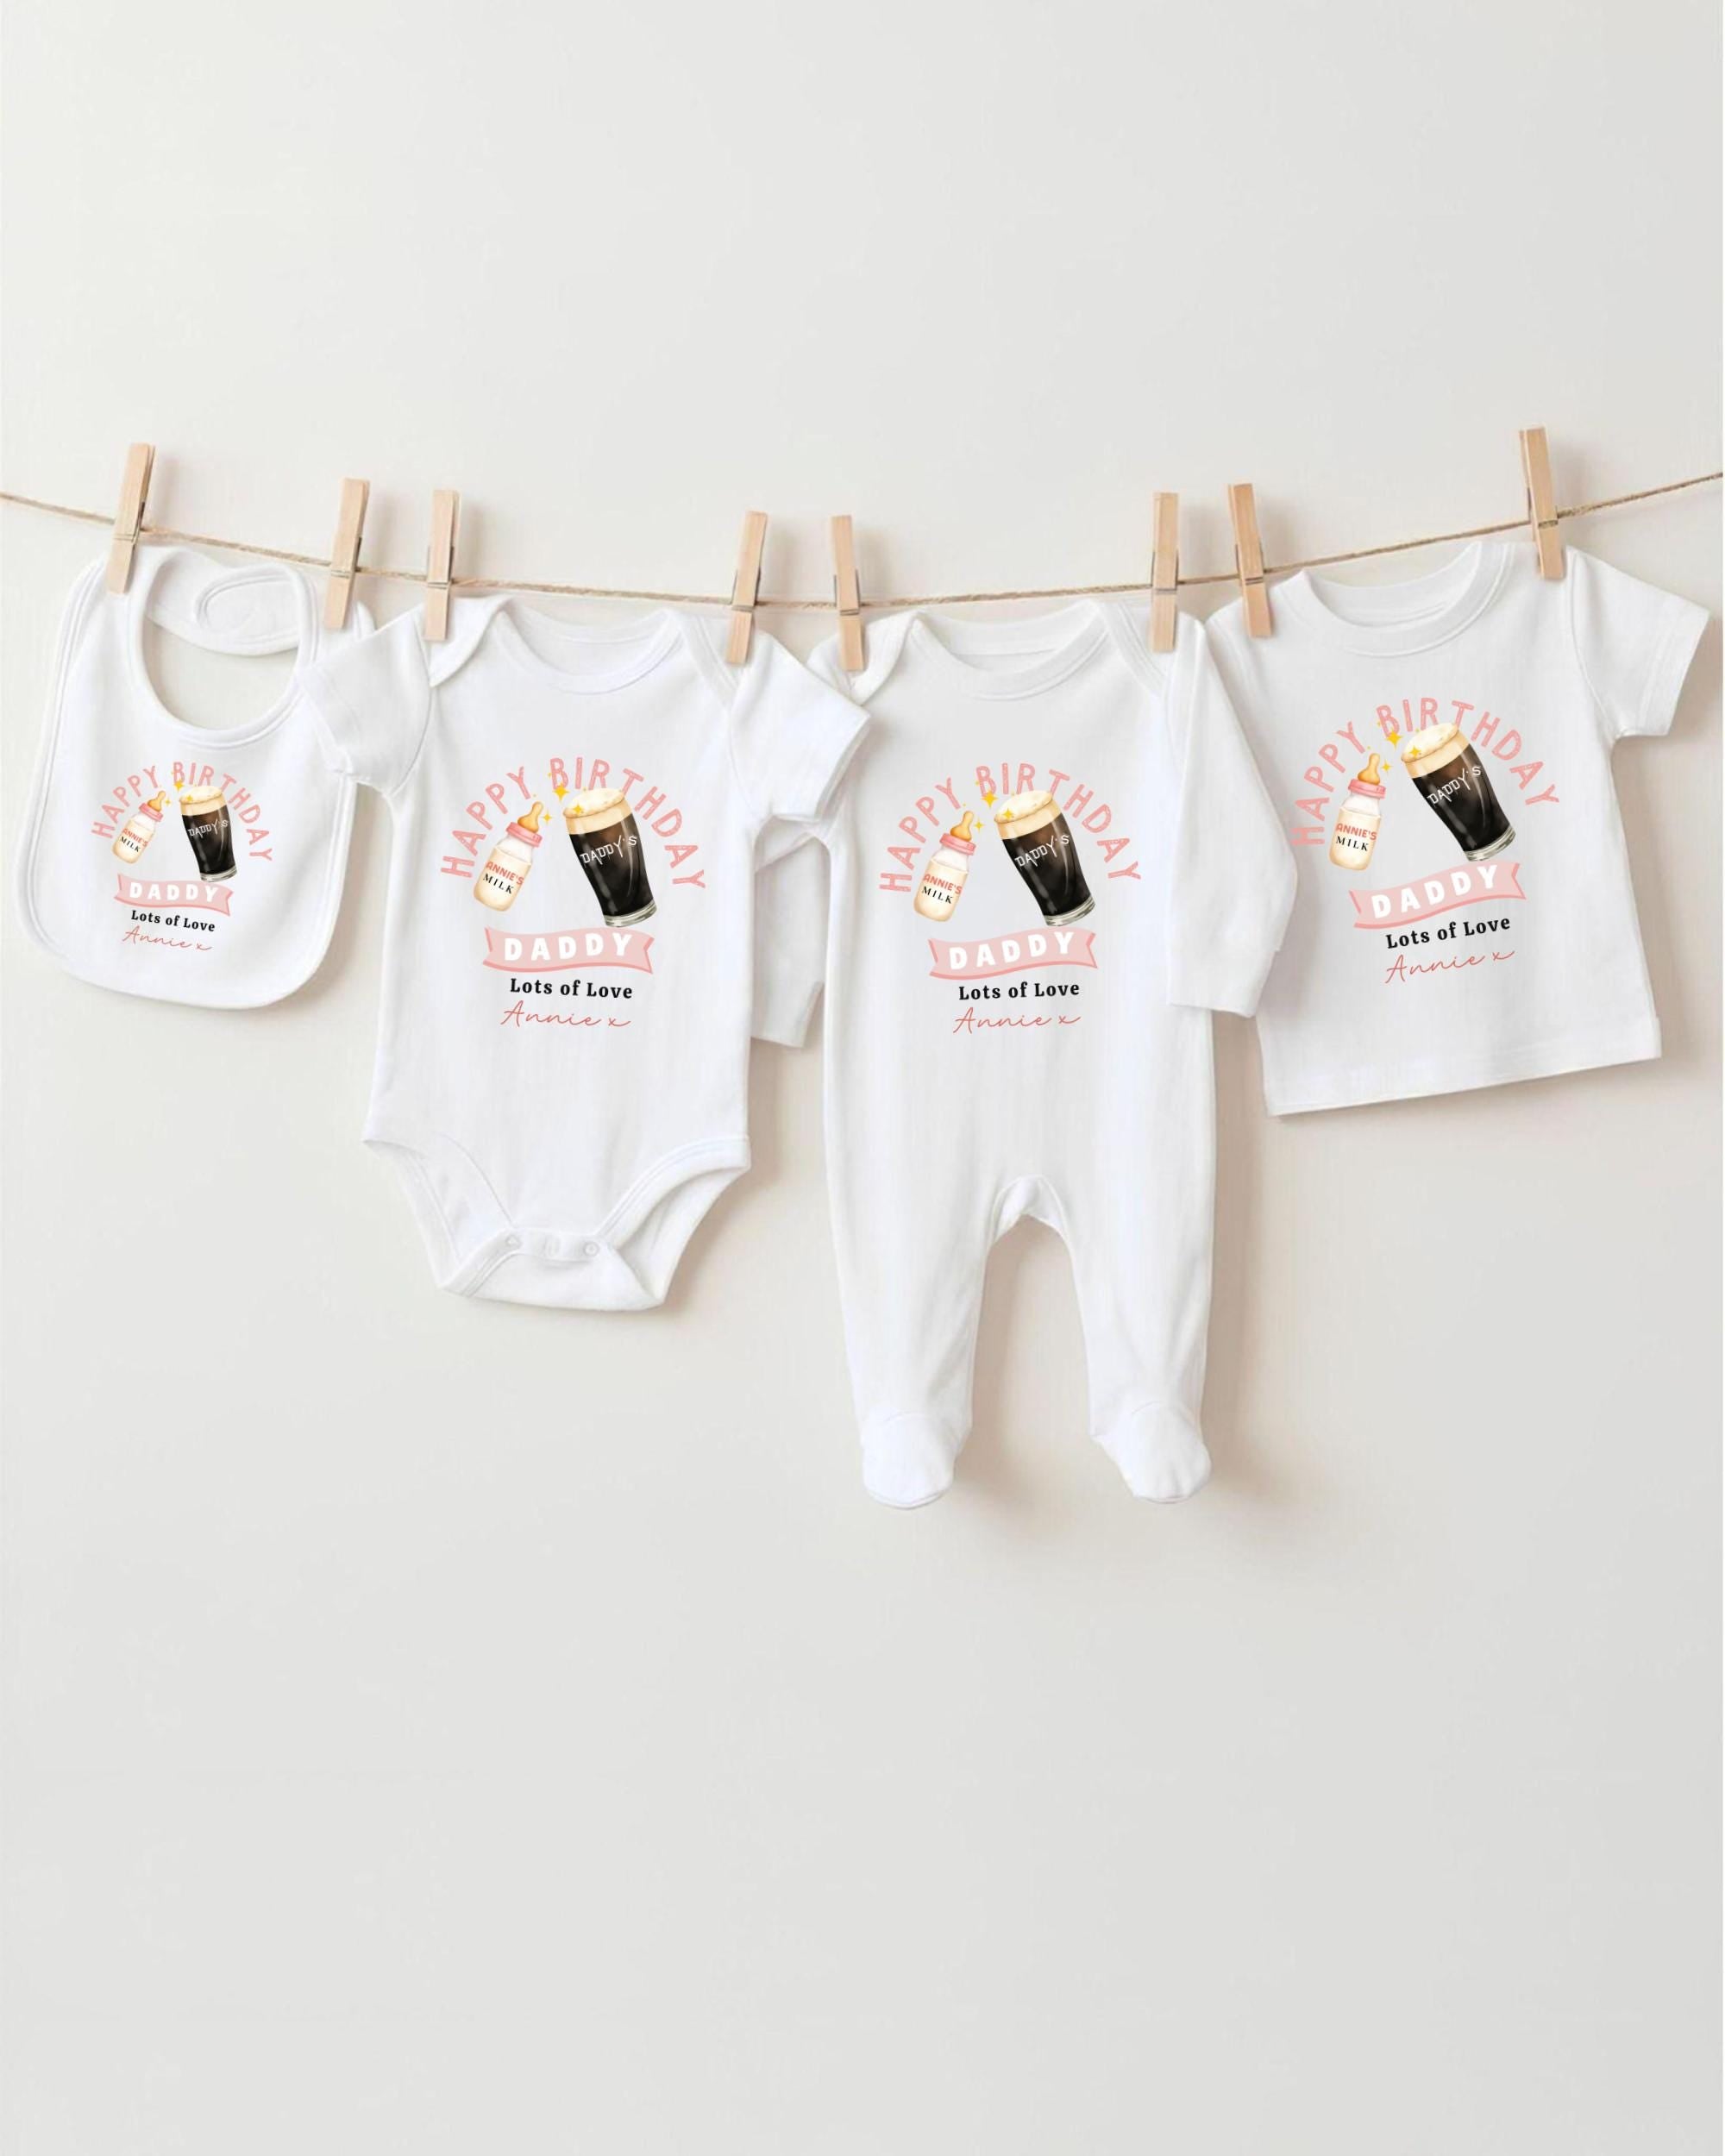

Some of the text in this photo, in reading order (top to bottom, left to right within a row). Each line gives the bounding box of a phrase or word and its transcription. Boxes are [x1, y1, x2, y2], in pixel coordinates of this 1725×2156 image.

[1289, 698, 1559, 845] HAPPY BIRTHDAY
[1427, 766, 1481, 805] DADDY'S
[91, 761, 273, 862] HAPPY BIRTHDAY
[441, 757, 706, 888] HAPPY BIRTHDAY
[122, 828, 148, 847] ANNIE'S
[188, 818, 228, 838] DADDY'S
[879, 762, 1141, 892] HAPPY BIRTHDAY
[1335, 823, 1377, 841] ANNIE'S
[120, 837, 141, 852] MILK
[580, 835, 637, 864] DADDY'S
[1015, 835, 1069, 868] DADDY'S
[1335, 836, 1369, 851] MILK
[483, 874, 514, 894] MILK
[486, 861, 524, 885] ANNIE'S
[923, 874, 962, 894] ANNIE'S
[130, 882, 218, 902] DADDY
[922, 887, 953, 904] MILK
[1371, 865, 1497, 918] DADDY
[131, 910, 215, 931] Lots of Love
[122, 925, 191, 948] Annie
[1386, 918, 1510, 949] Lots of Love
[505, 933, 632, 961] DADDY
[950, 931, 1074, 969] DADDY
[1385, 954, 1485, 984] Annie
[511, 978, 632, 999] Lots of Love
[959, 981, 1080, 1000] Lots of Love
[500, 1000, 601, 1027] Annie
[953, 1007, 1052, 1034] Annie
